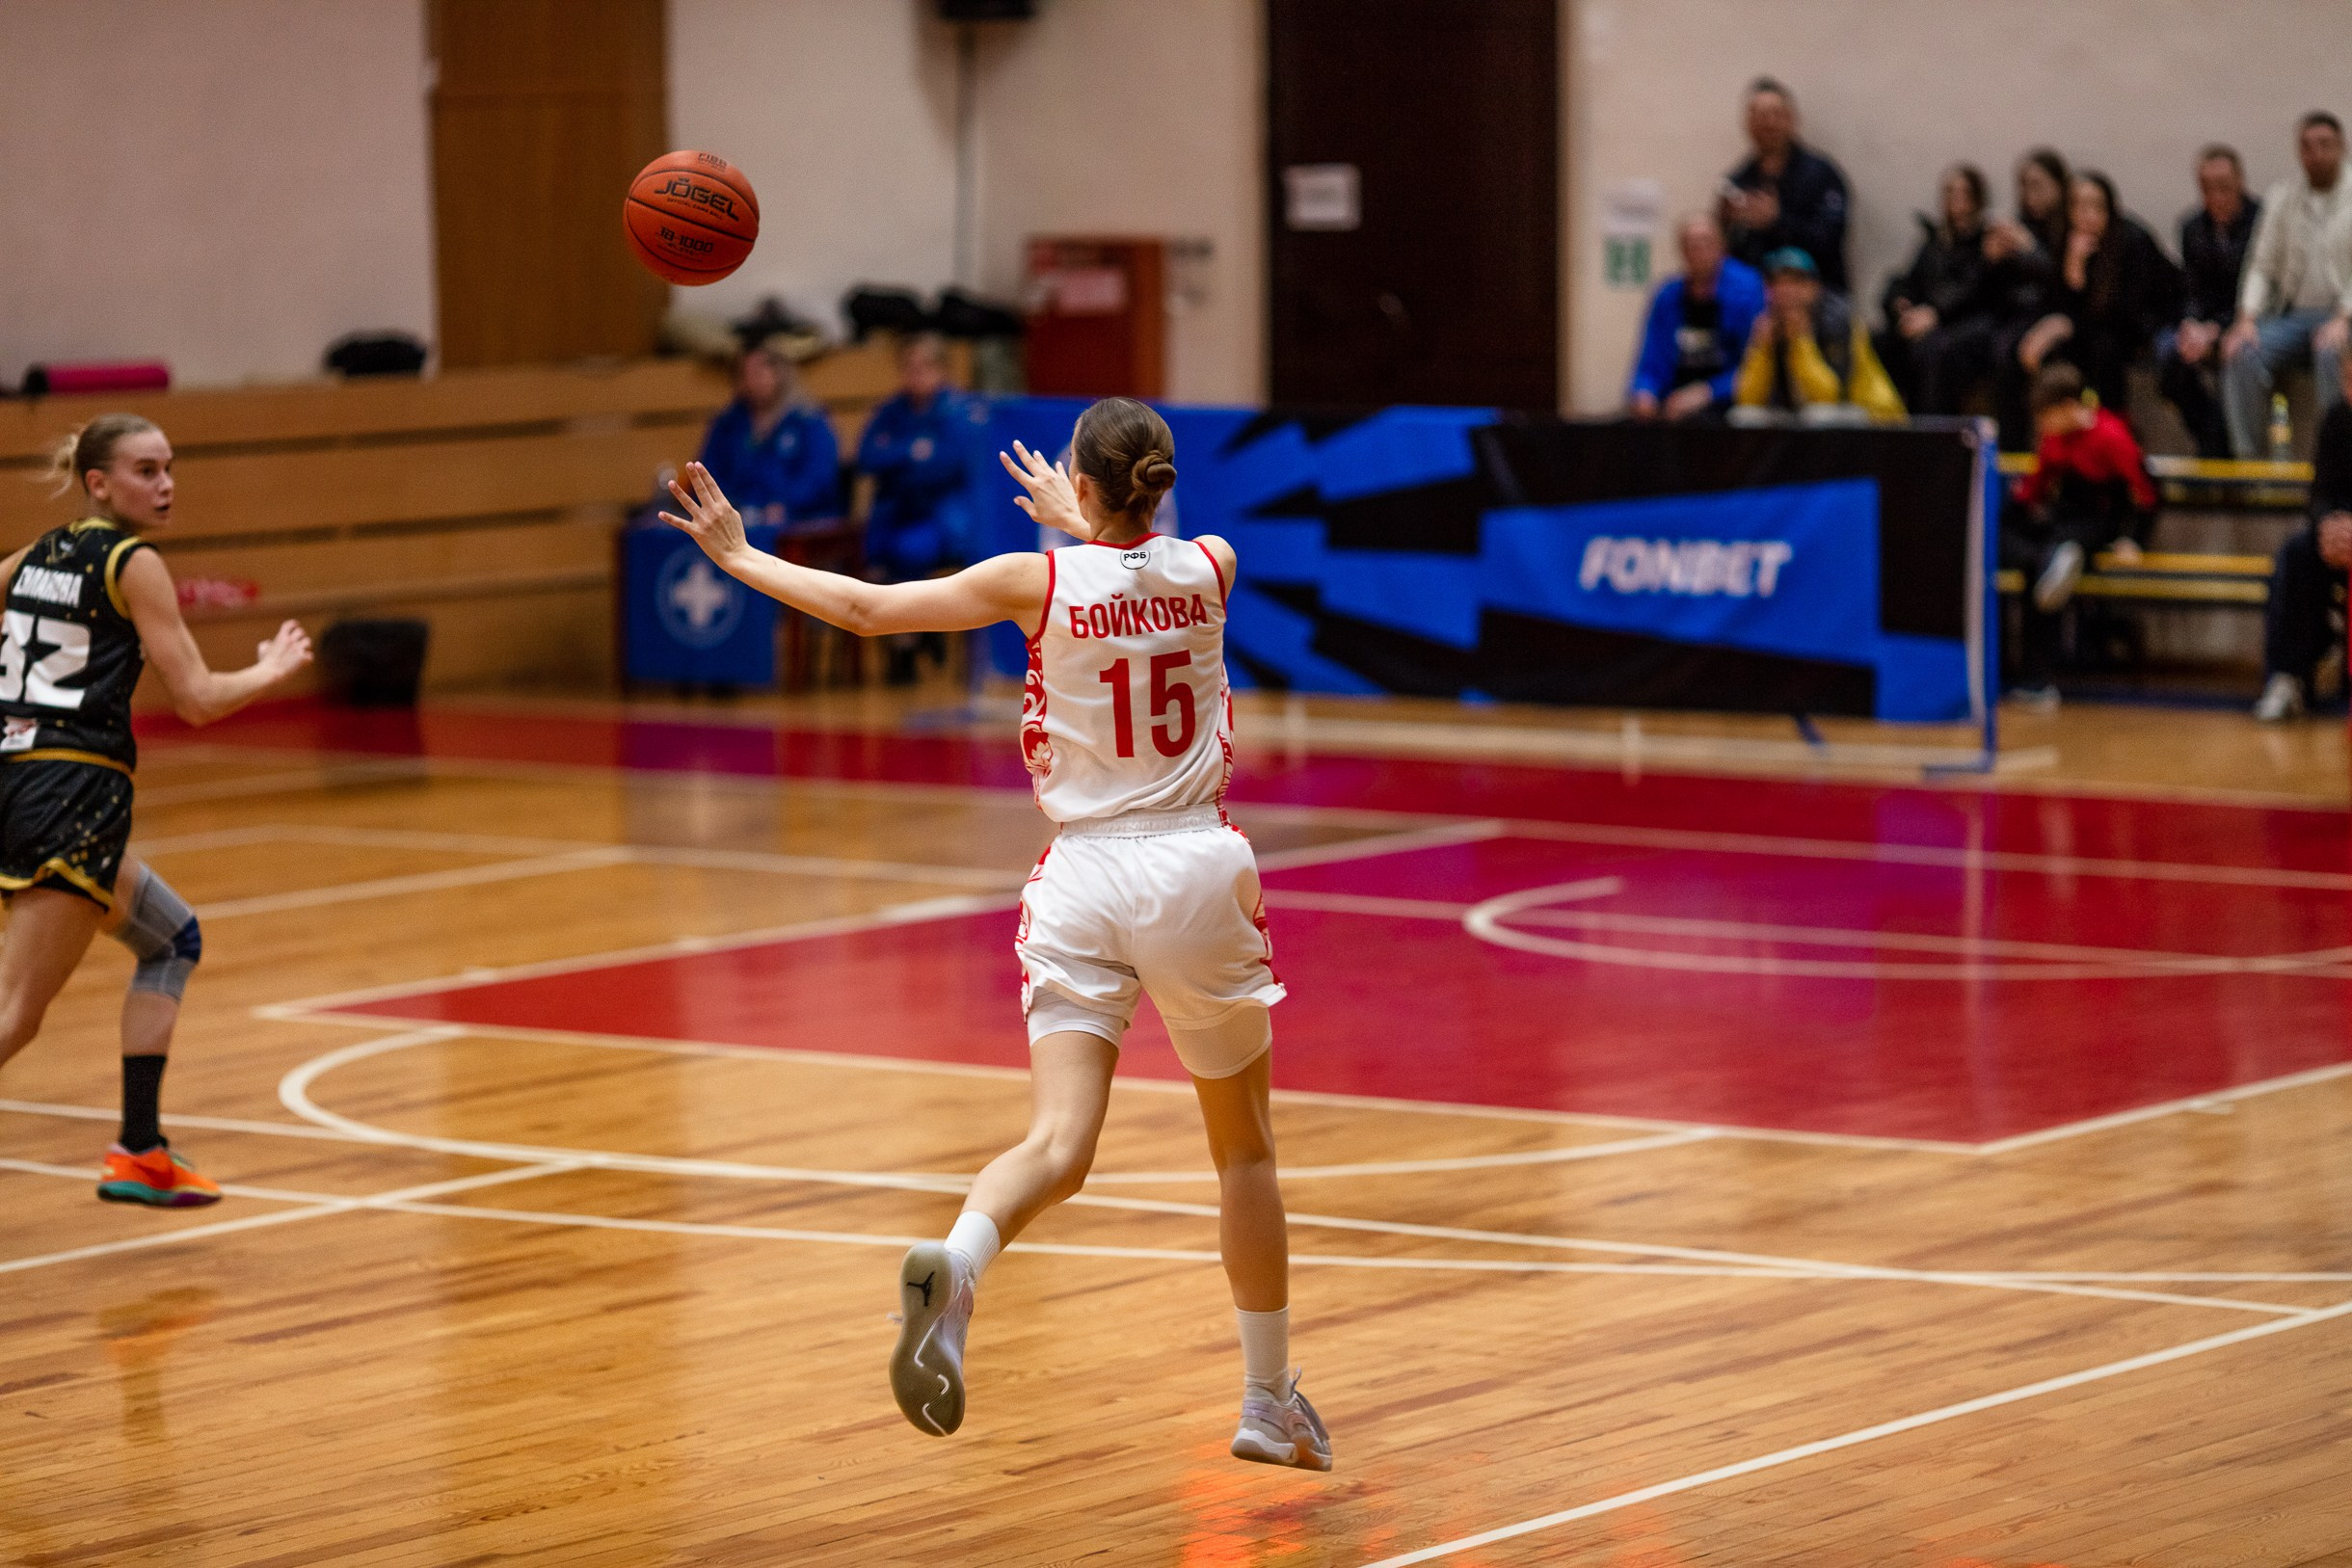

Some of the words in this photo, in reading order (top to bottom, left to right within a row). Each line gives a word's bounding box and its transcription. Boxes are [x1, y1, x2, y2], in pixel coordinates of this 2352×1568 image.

[654, 176, 739, 222] JÖGEL
[1123, 550, 1147, 562] РФБ
[1578, 536, 1793, 598] FONBET
[1069, 593, 1208, 639] БОЙКОВА
[0, 609, 91, 710] 32
[1099, 649, 1196, 758] 15
